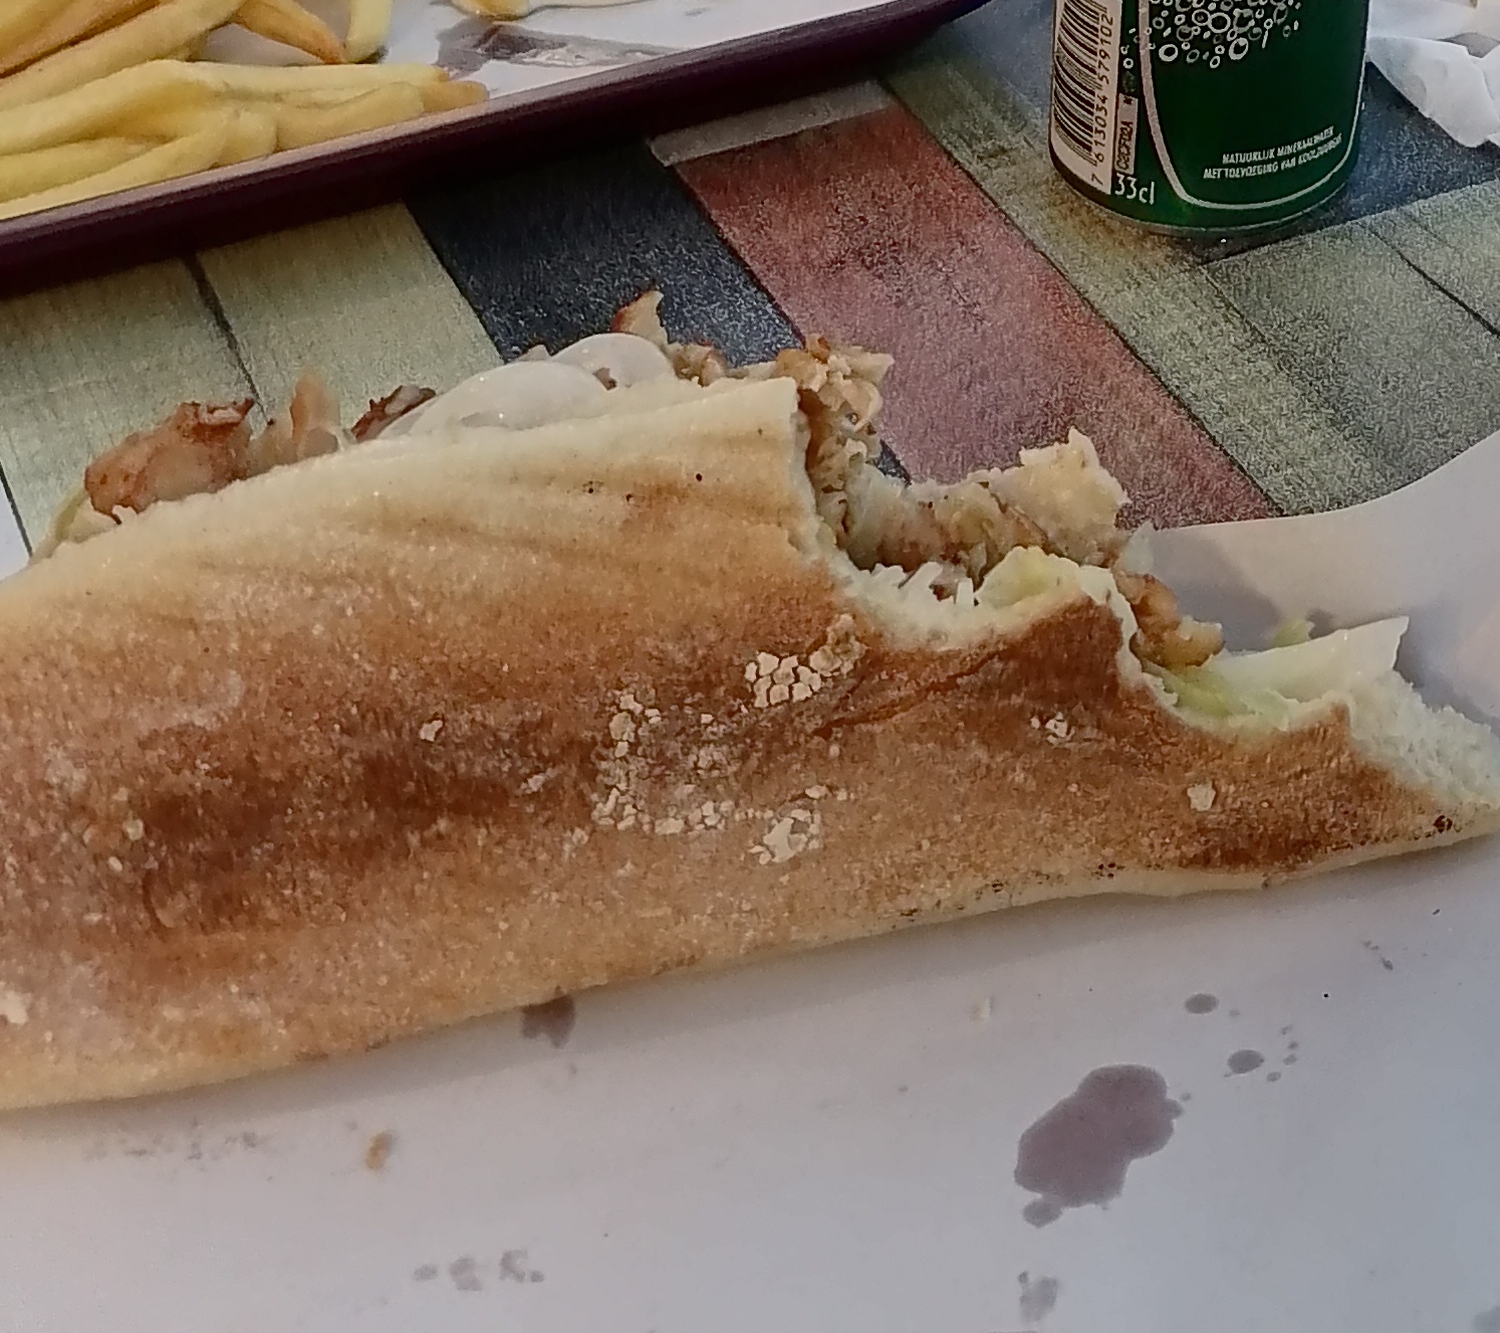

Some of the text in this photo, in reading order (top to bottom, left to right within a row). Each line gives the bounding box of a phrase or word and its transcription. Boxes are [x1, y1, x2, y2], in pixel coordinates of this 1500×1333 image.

[1091, 14, 1115, 186] 7 613034 579102
[1114, 173, 1155, 205] 33cl
[1203, 167, 1222, 180] MET
